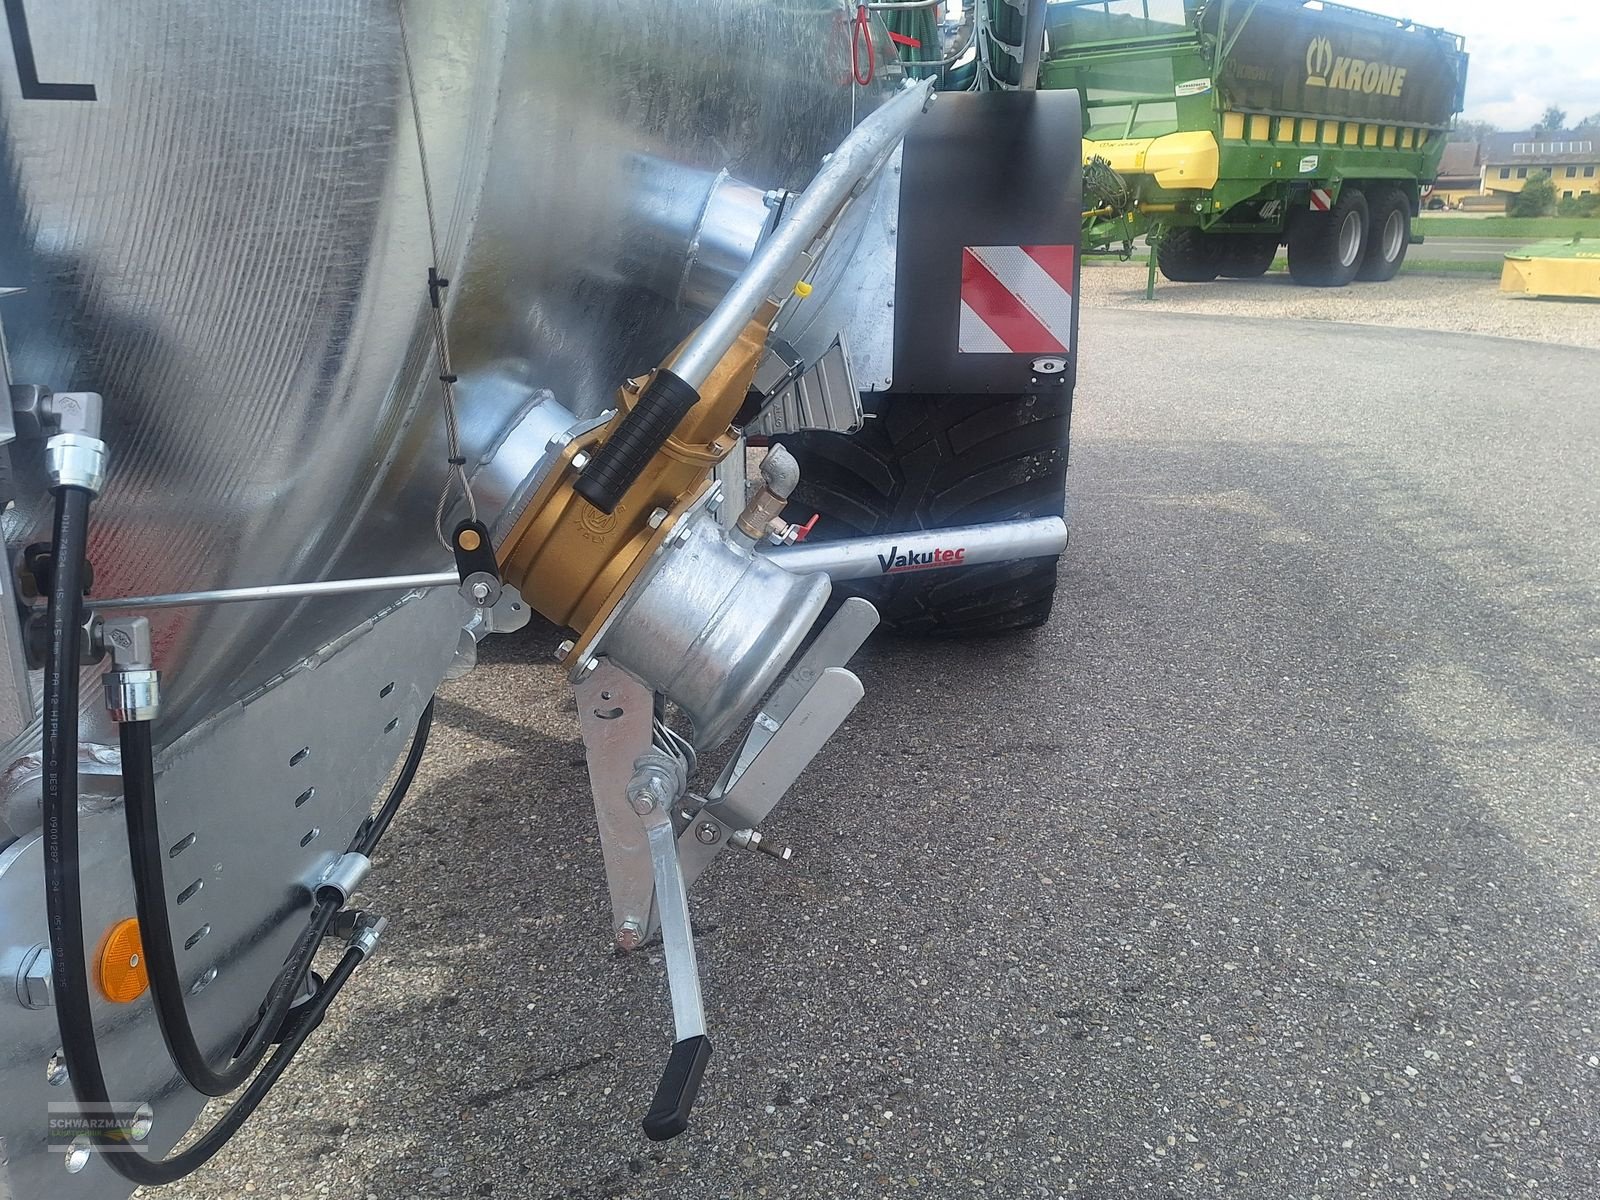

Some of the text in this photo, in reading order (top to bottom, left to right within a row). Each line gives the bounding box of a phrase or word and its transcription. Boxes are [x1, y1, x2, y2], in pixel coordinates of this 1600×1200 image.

[1328, 56, 1408, 97] KRONE
[61, 514, 70, 533] DIN
[58, 538, 68, 568] 74324
[877, 546, 965, 573] Vakutec
[56, 587, 65, 599] 15
[51, 672, 60, 686] PA
[50, 693, 59, 705] 12
[50, 710, 59, 742] HIPHL
[50, 773, 58, 798] BEST
[50, 816, 60, 864] 09001287
